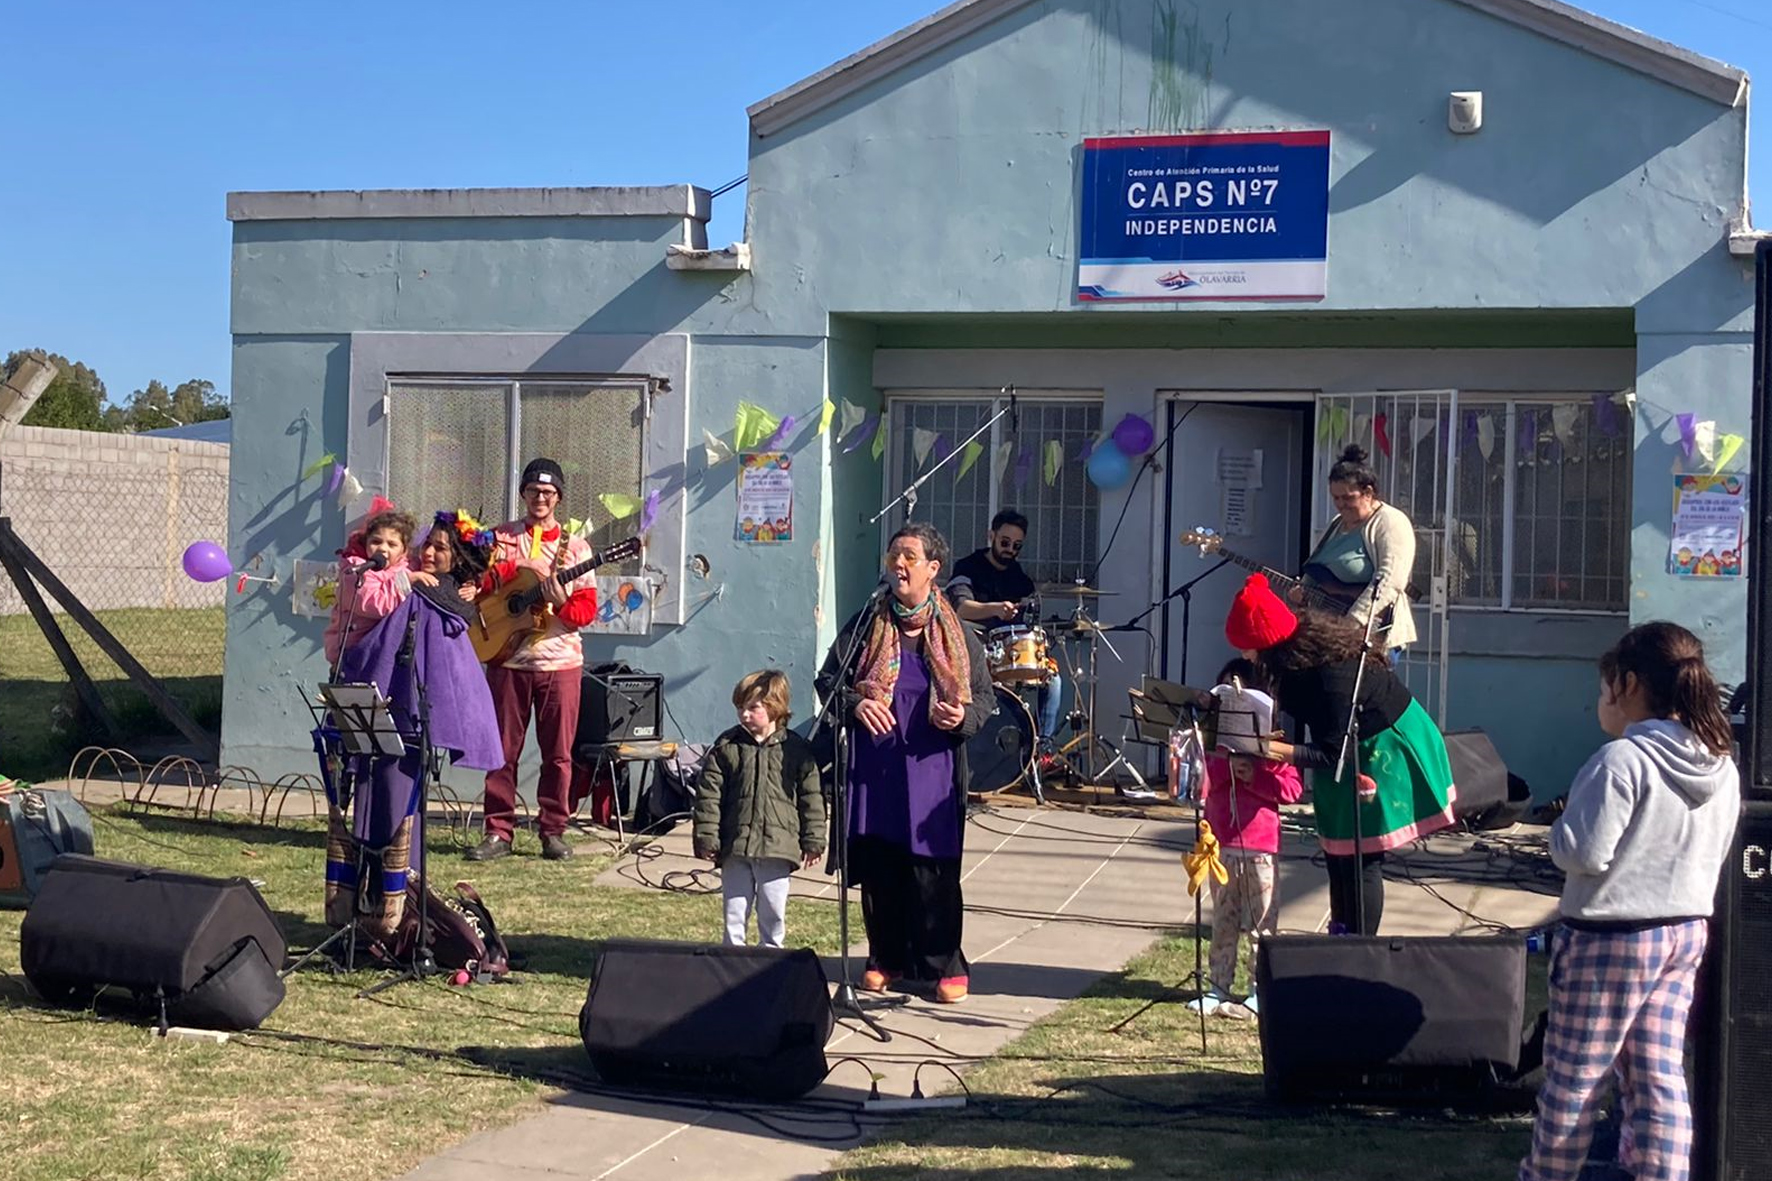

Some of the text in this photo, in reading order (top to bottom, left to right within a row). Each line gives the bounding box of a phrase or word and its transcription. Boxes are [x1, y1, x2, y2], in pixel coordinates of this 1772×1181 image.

[1127, 168, 1154, 177] Centro
[1155, 168, 1165, 176] de
[1202, 166, 1235, 175] Primaria
[1236, 165, 1246, 174] de
[1247, 165, 1255, 174] la
[1257, 164, 1279, 173] Salud
[1127, 179, 1214, 209] CAPS
[1125, 217, 1277, 236] INDEPENDENCIA
[1743, 845, 1772, 878] C
